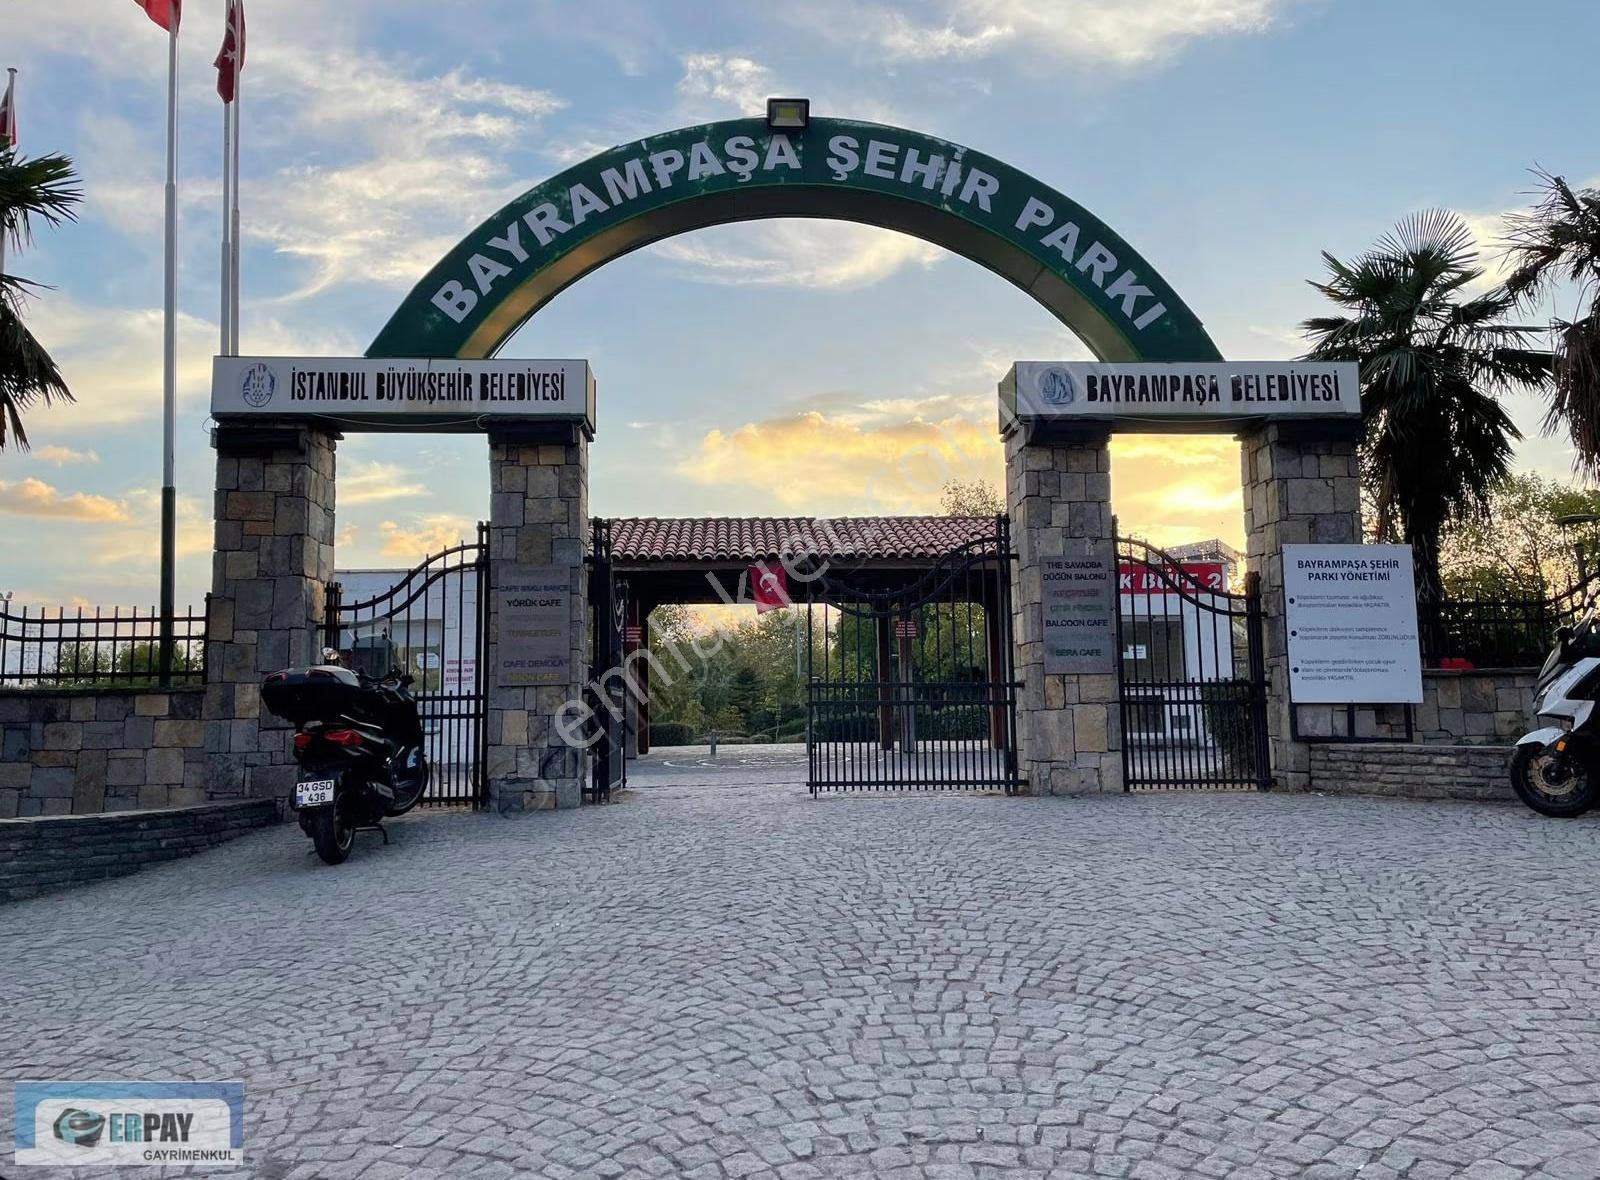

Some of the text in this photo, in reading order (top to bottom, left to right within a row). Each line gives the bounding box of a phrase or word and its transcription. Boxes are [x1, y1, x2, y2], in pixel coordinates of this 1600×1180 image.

[430, 134, 1167, 331] BAYRAMPAŞA ŞEHİR PARKI
[290, 366, 565, 405] İSTANBUL BÜYÜKŞEHİR BELEDİYESİ
[1086, 369, 1341, 405] BAYRAMPAŞA BELEDİYESİ
[1047, 561, 1063, 570] THE
[1297, 557, 1399, 571] BAYRAMPAŞA ŞEHİR
[1042, 571, 1073, 581] DÜĞÜN
[1207, 572, 1222, 589] 2
[1307, 570, 1390, 581] PARKI YÖNETİMİ
[506, 598, 562, 608] YÖRÜK CAFE
[1087, 619, 1109, 627] CAFE
[1080, 648, 1103, 657] CAFE
[299, 781, 332, 793] 34 GSD
[308, 792, 326, 802] 436
